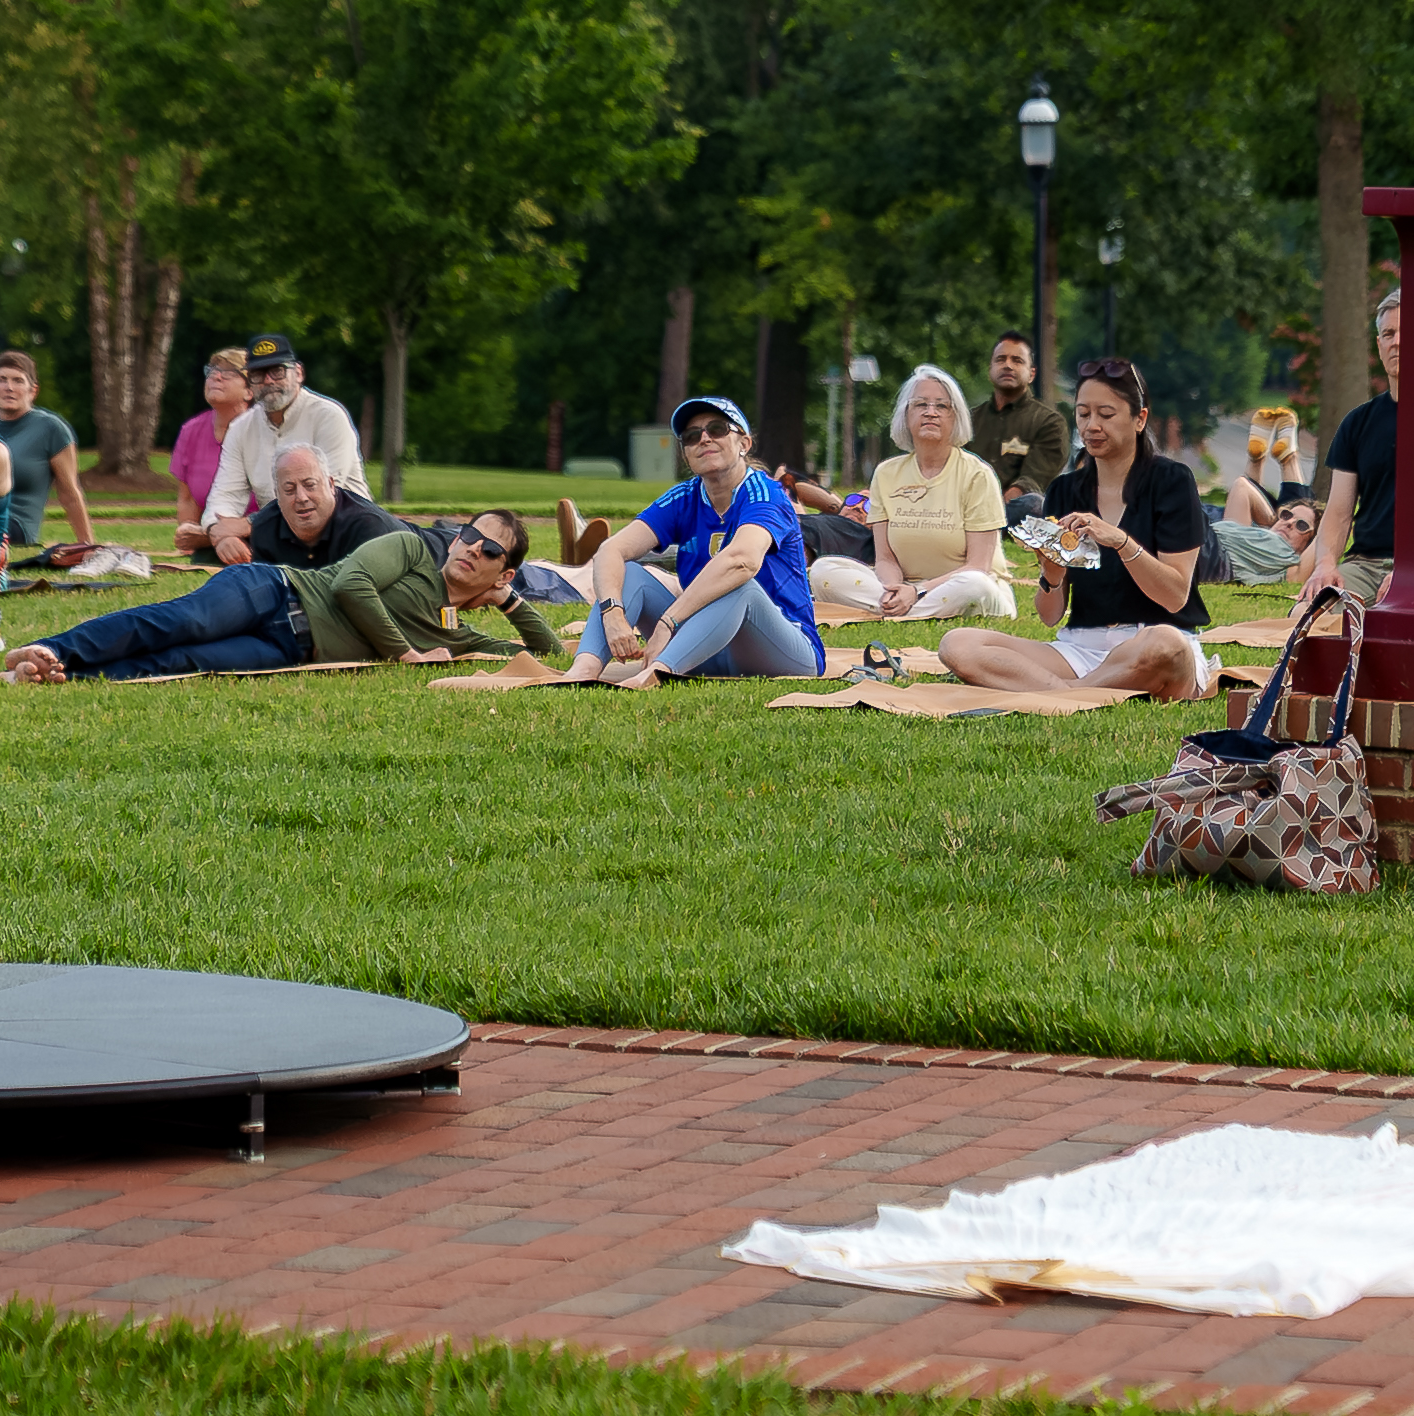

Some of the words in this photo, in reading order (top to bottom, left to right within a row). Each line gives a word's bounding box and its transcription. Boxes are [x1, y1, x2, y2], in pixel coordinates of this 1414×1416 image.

[895, 508, 941, 518] Radicalized
[942, 508, 953, 521] by
[890, 520, 919, 529] tactical
